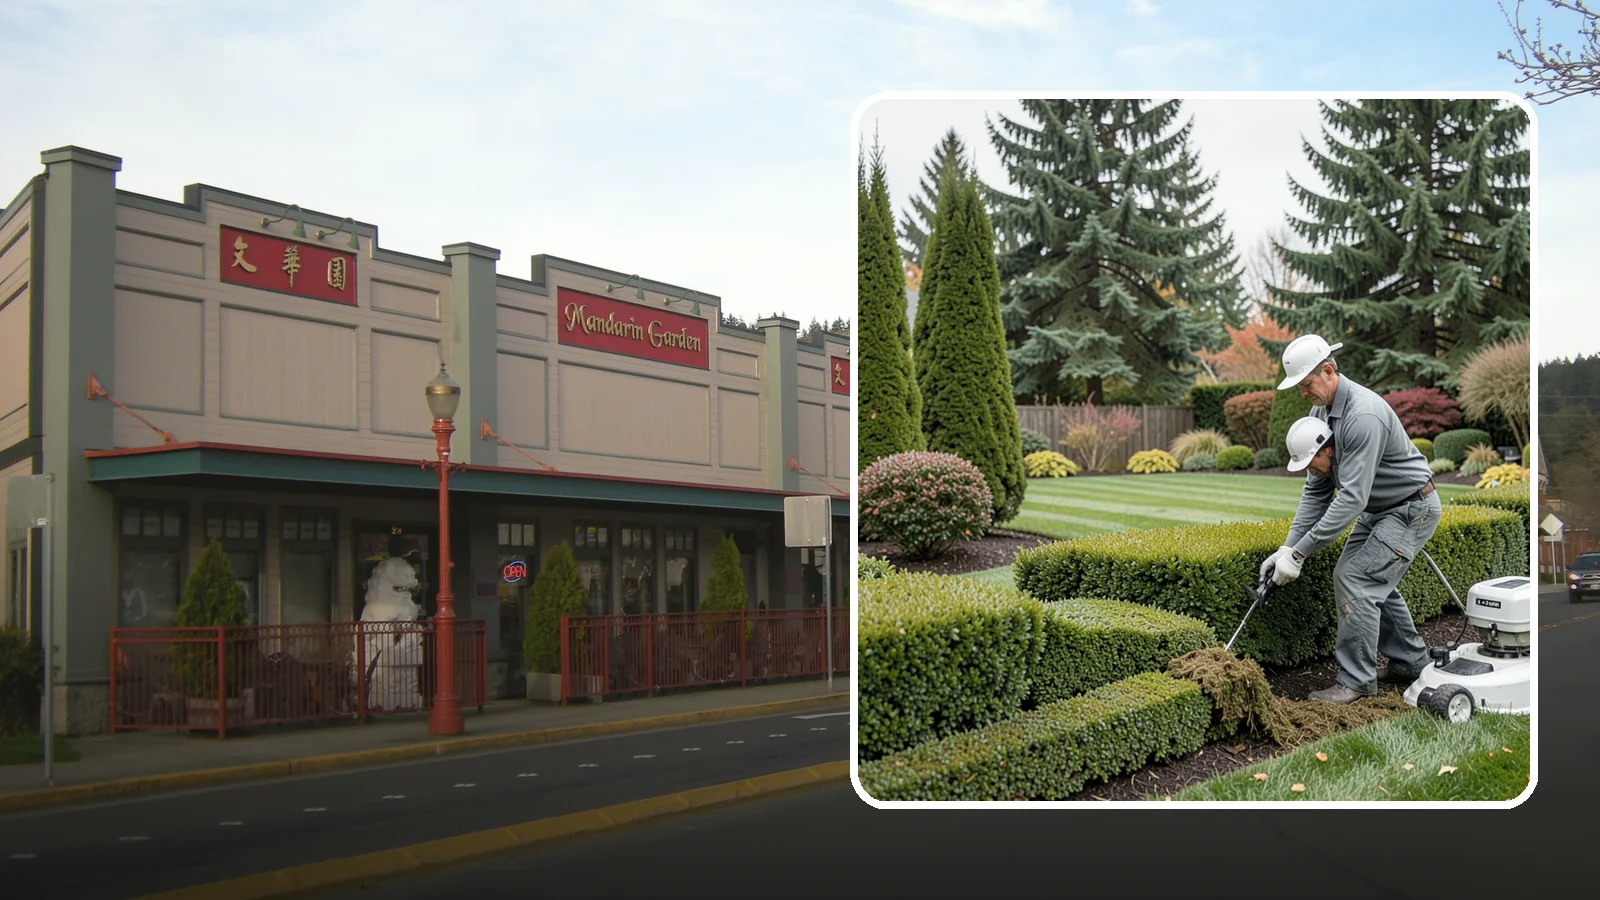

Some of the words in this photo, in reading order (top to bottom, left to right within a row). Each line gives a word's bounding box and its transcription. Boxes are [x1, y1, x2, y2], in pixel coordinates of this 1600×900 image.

[230, 235, 345, 291] 文華園
[564, 302, 643, 341] Mandarin
[648, 320, 701, 352] Garden
[503, 565, 527, 578] OPEN
